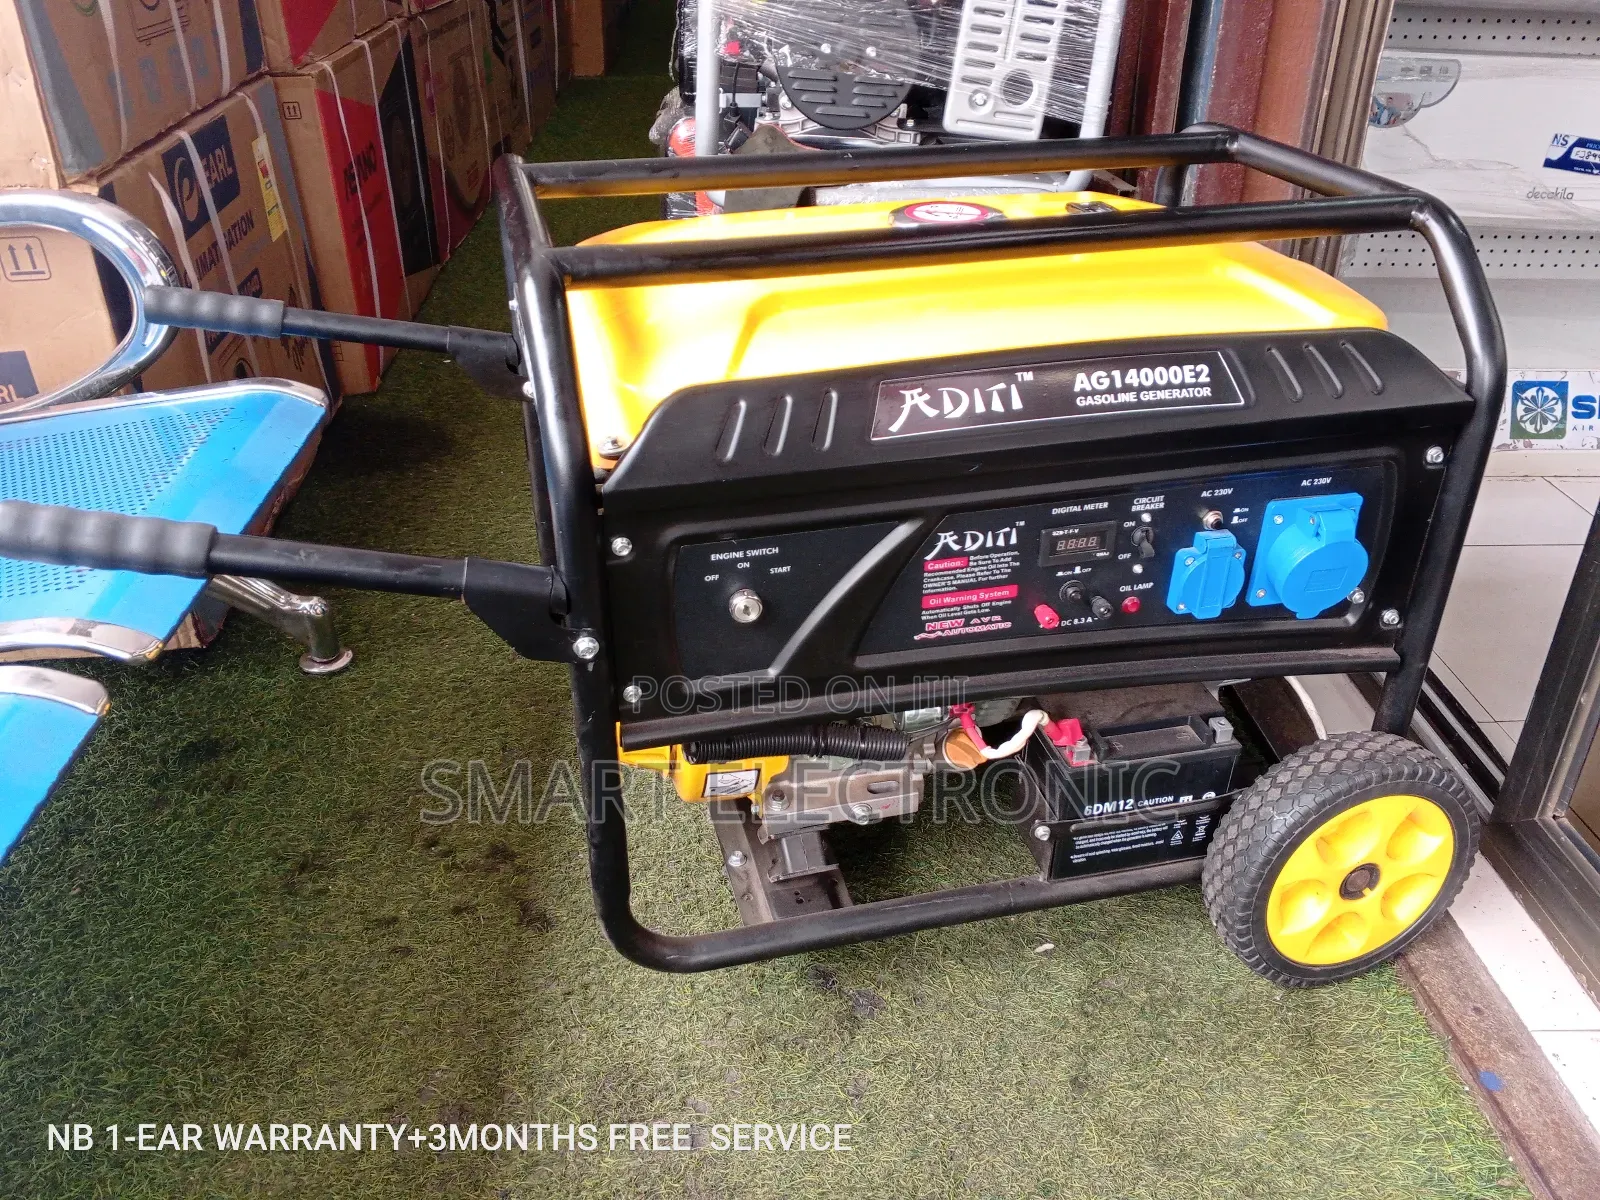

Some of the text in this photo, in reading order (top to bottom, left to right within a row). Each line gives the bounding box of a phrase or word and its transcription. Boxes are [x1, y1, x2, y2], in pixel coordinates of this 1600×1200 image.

[1552, 133, 1570, 147] NS
[1073, 363, 1211, 393] AG14000E2
[1076, 386, 1212, 407] GASOLINE GENERATOR
[1301, 477, 1332, 487] AC 230V
[1201, 488, 1233, 498] AC 230V
[1133, 495, 1165, 505] CIRCUIT
[1052, 501, 1109, 515] DIGITAL METER
[1131, 502, 1165, 512] BREAKER
[710, 546, 779, 561] ENGINE SWITCH
[769, 566, 791, 574] START
[928, 560, 963, 570] Caution:
[704, 574, 719, 582] OFF
[1133, 582, 1154, 591] LAMP
[943, 593, 977, 604] Warning
[978, 590, 1010, 600] System
[925, 618, 965, 631] NEW
[1073, 617, 1085, 625] 8.3
[1084, 795, 1174, 816] 6DM12 CAUTION
